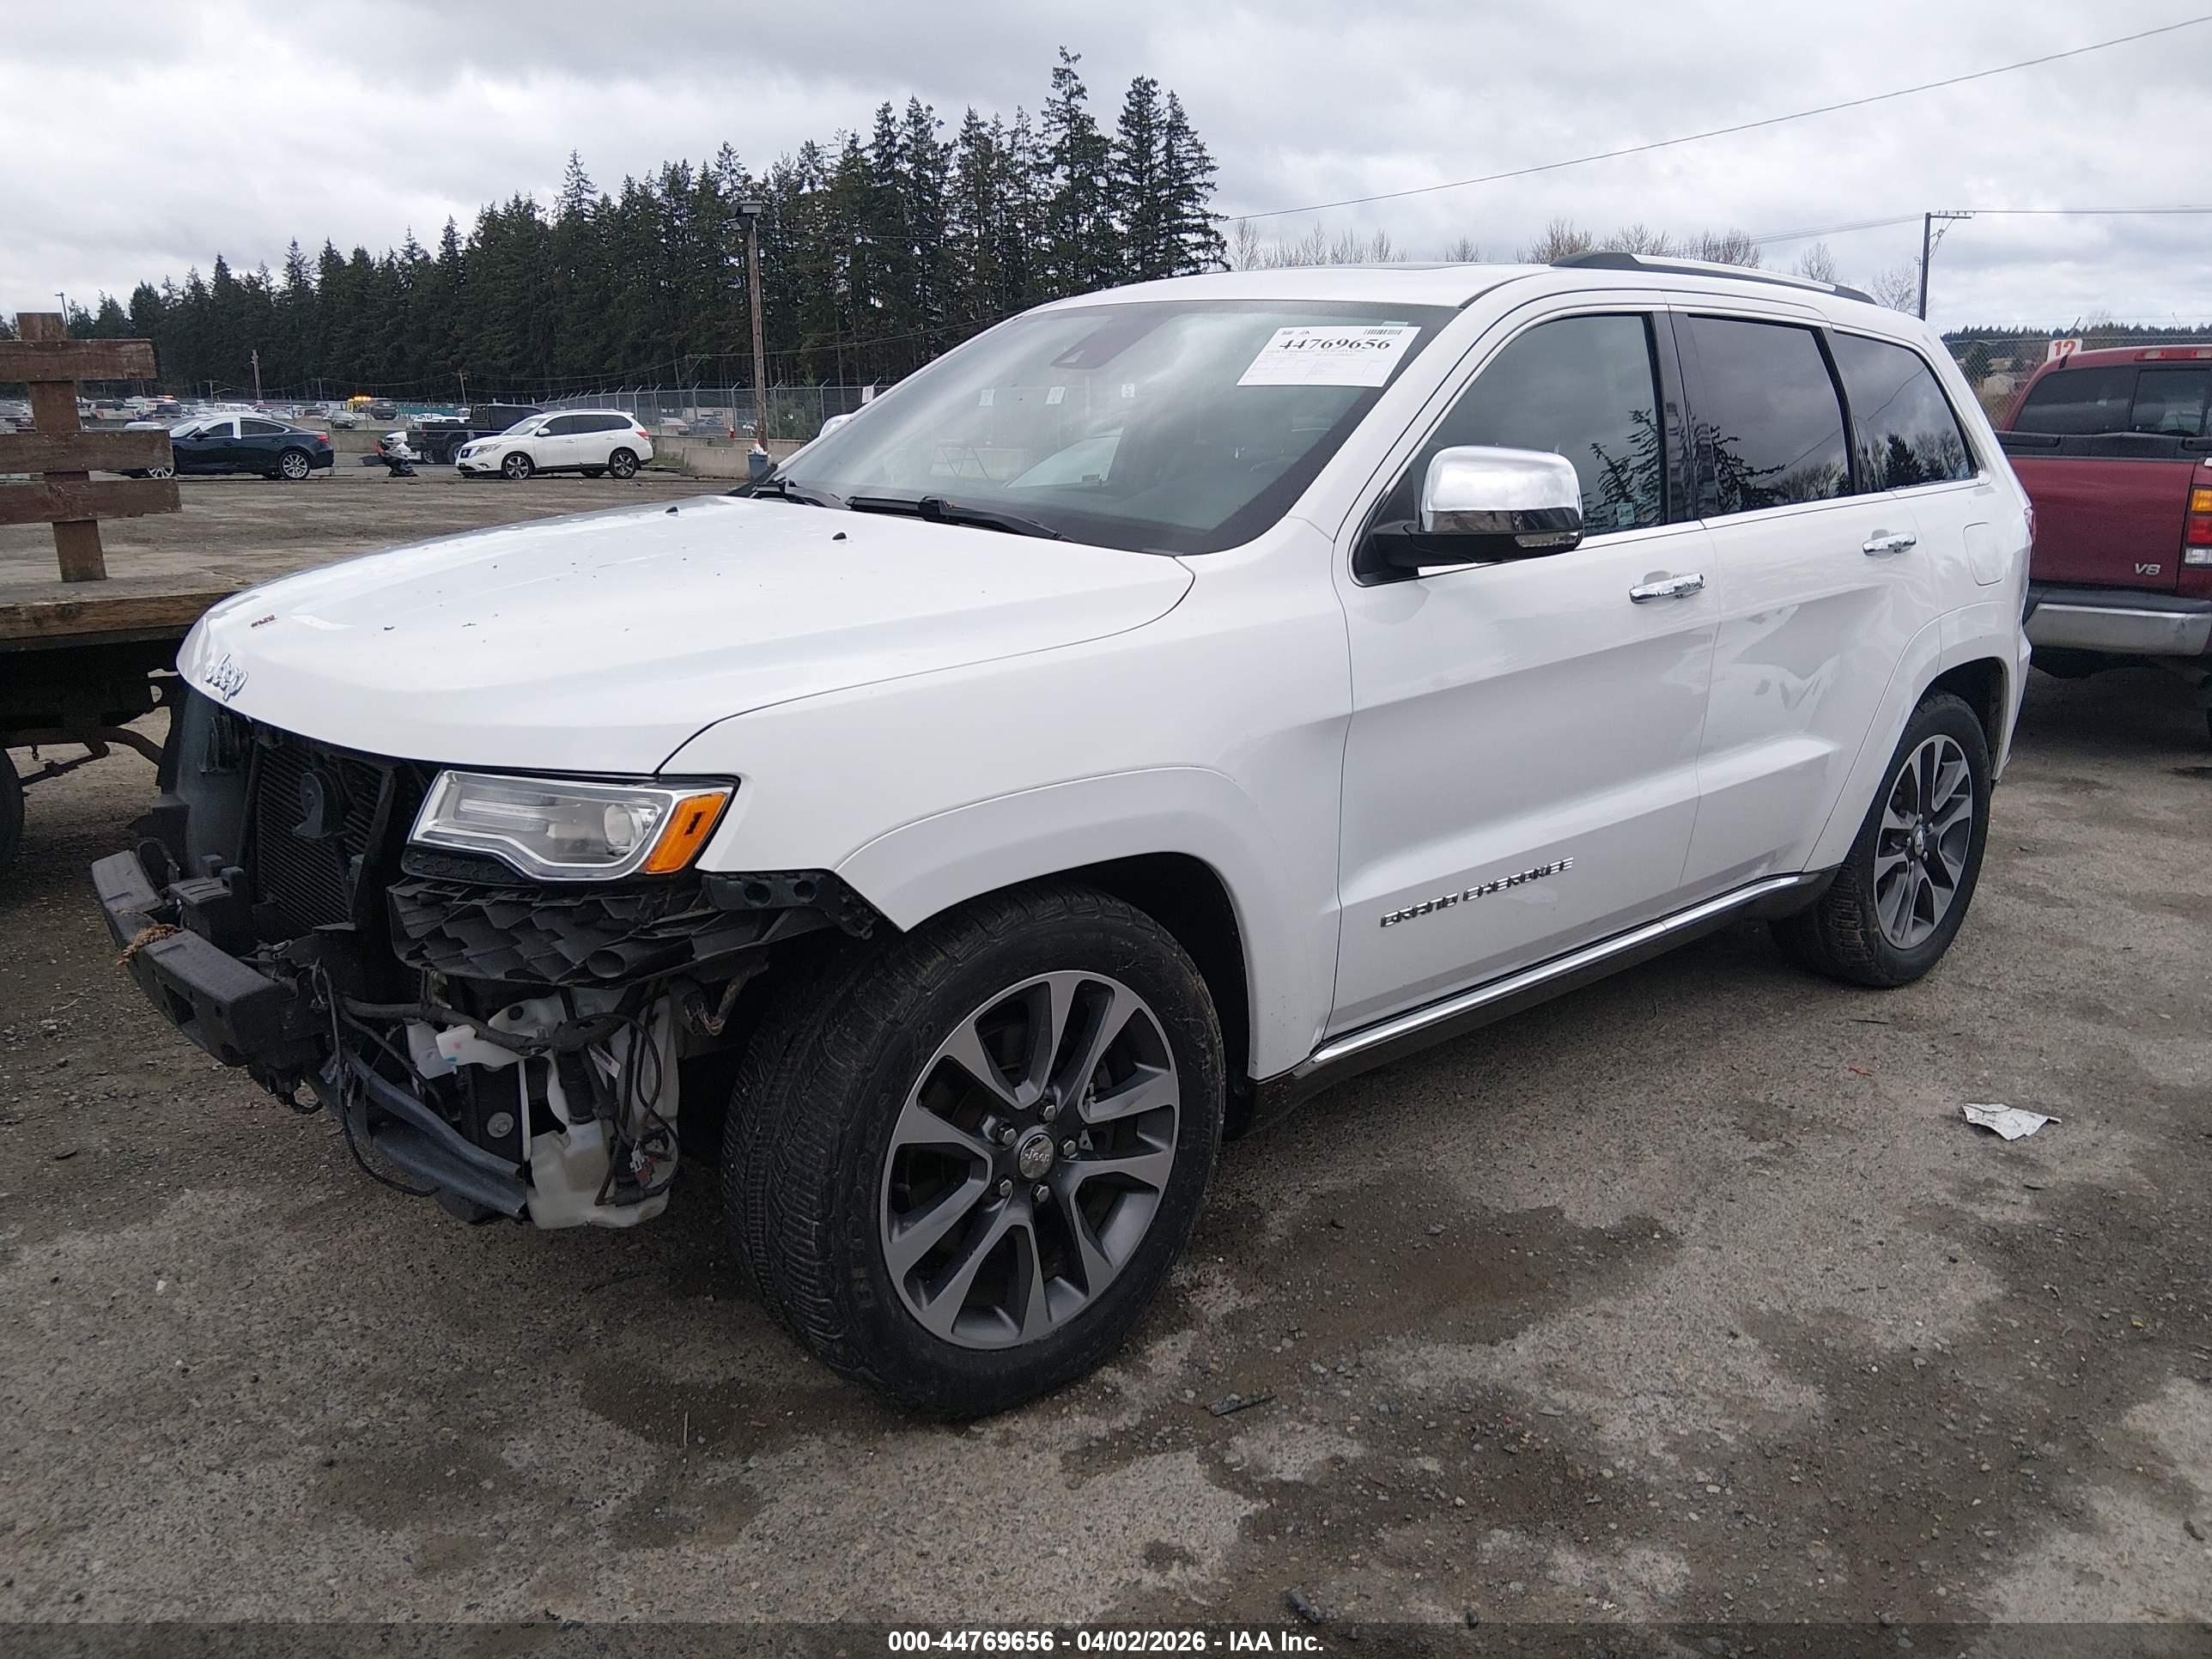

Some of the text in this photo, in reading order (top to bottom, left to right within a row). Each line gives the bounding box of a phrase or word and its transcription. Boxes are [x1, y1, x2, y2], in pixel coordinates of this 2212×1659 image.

[1279, 337, 1395, 349] 44769656
[2054, 341, 2076, 357] 12
[2135, 562, 2161, 575] V8
[205, 653, 248, 702] Jeep
[1380, 856, 1574, 927] GRAND CHEROKEE
[1024, 1148, 1050, 1164] Jeep
